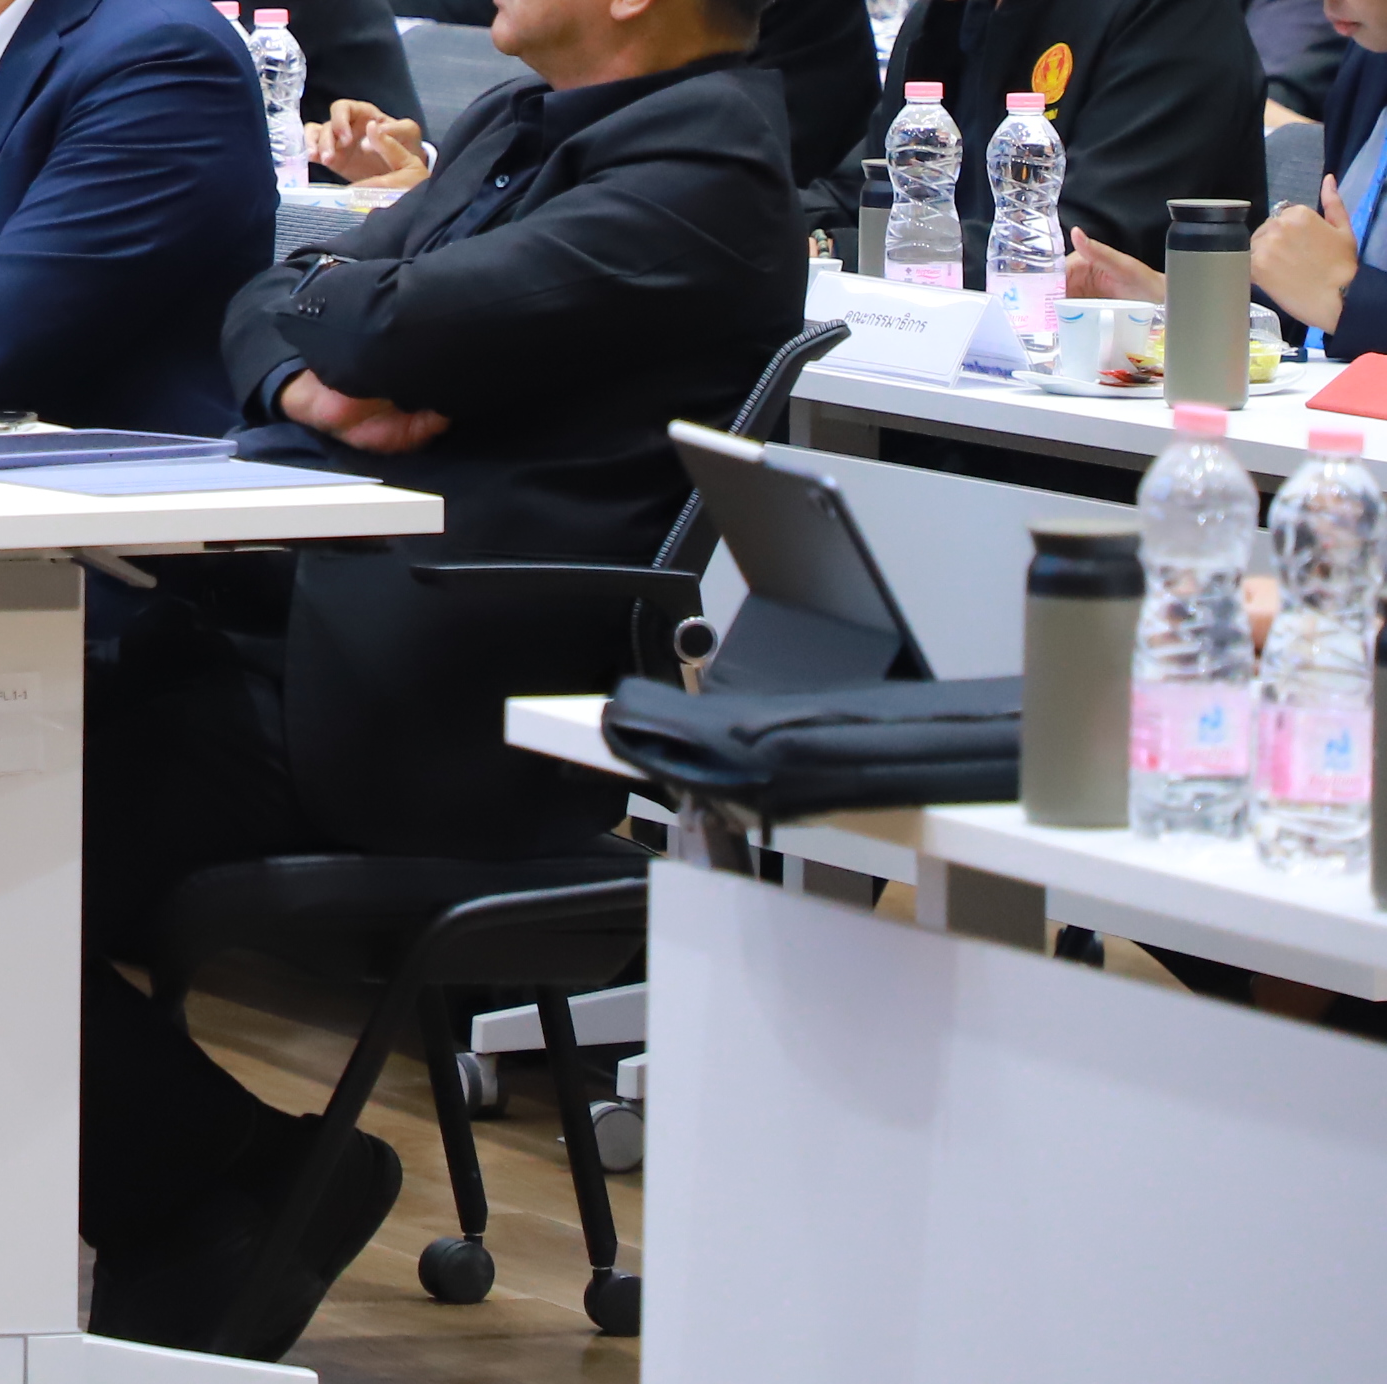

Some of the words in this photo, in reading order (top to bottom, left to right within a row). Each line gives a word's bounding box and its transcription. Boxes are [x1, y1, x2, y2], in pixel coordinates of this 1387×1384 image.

[843, 310, 928, 333] คณะกรรมาธิการ
